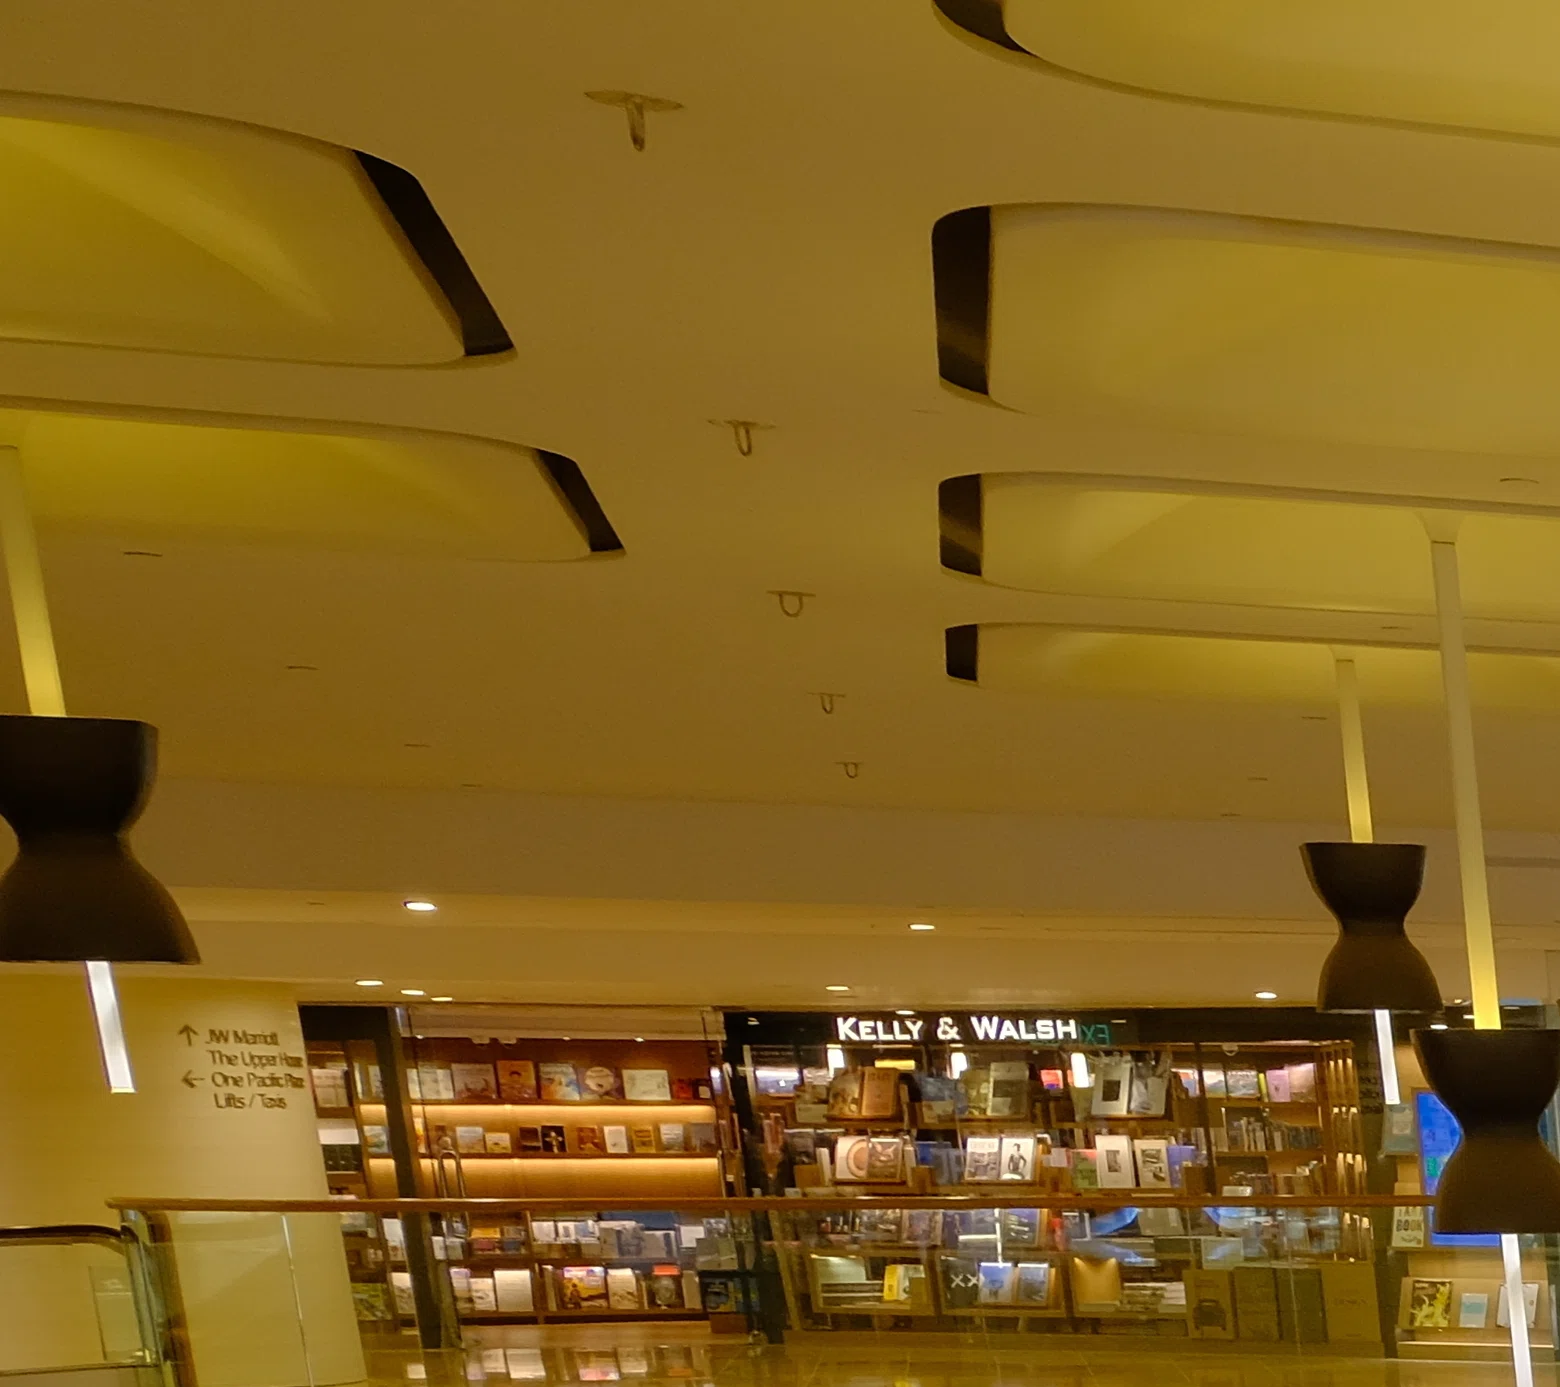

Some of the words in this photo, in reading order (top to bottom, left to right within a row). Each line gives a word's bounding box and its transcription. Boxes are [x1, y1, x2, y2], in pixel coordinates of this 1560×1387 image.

[836, 1017, 923, 1041] KELLY
[937, 1017, 961, 1040] &
[970, 1016, 1077, 1040] WALSH
[206, 1050, 238, 1066] The
[211, 1071, 243, 1087] One
